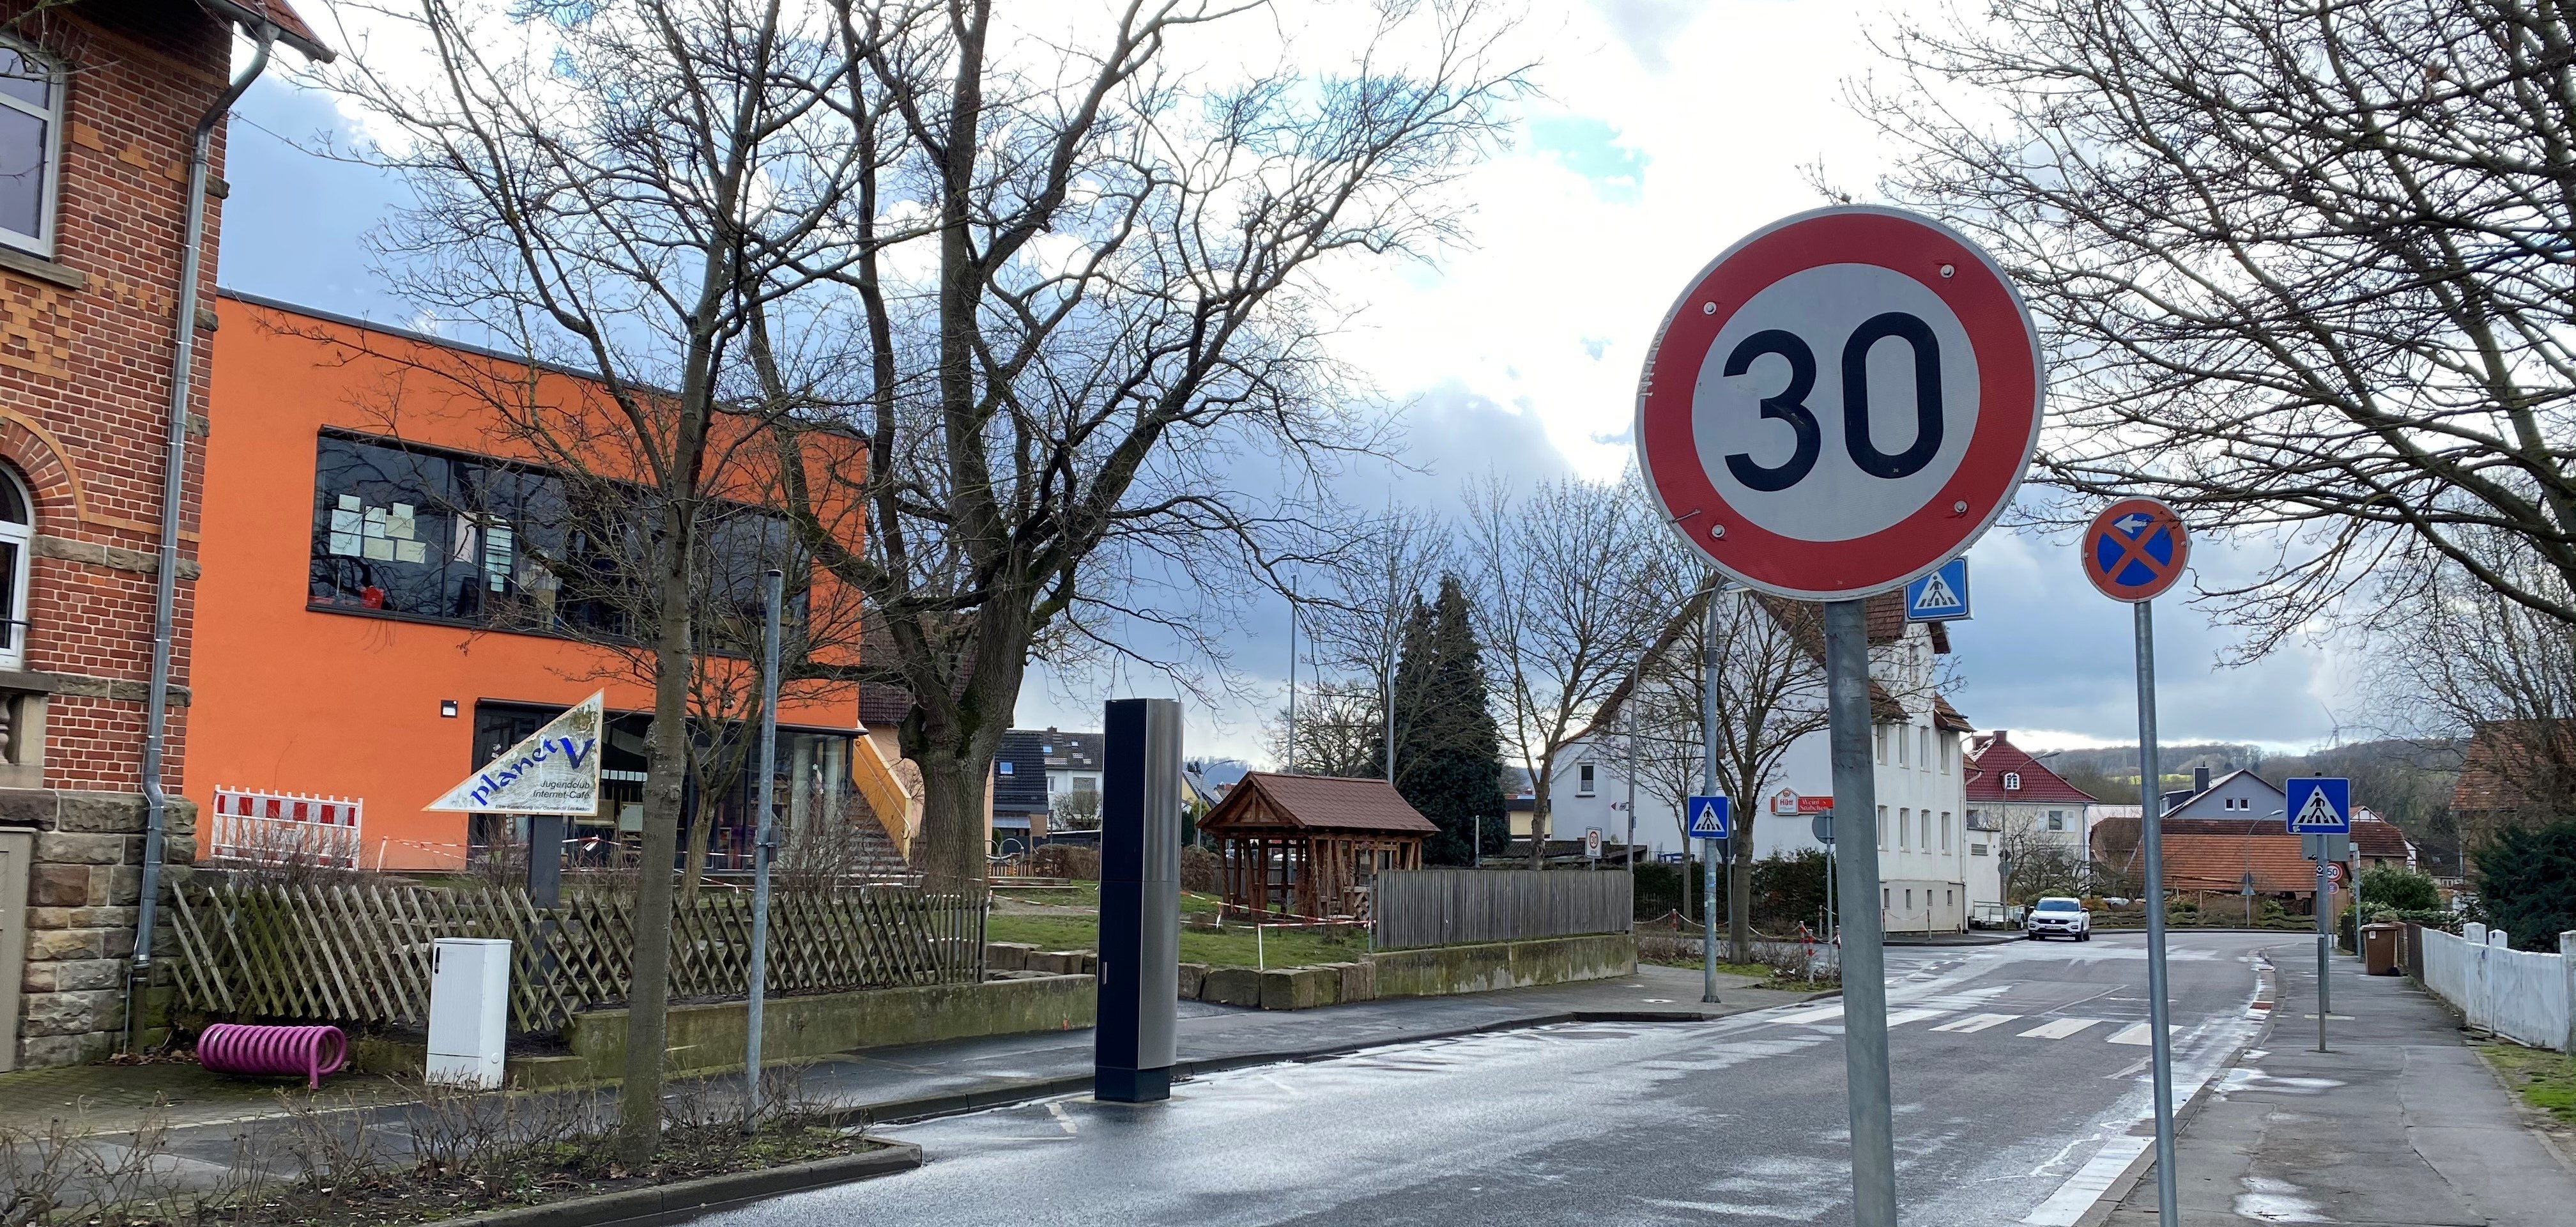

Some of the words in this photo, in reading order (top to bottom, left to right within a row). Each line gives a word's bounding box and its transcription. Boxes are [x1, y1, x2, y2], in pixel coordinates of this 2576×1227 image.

[1723, 312, 1943, 491] 30
[470, 739, 558, 806] planet
[558, 737, 597, 771] V
[540, 780, 590, 789] Jugendclub
[533, 790, 590, 799] Internet-Café
[1591, 835, 1597, 845] 30
[2327, 868, 2338, 876] 50
